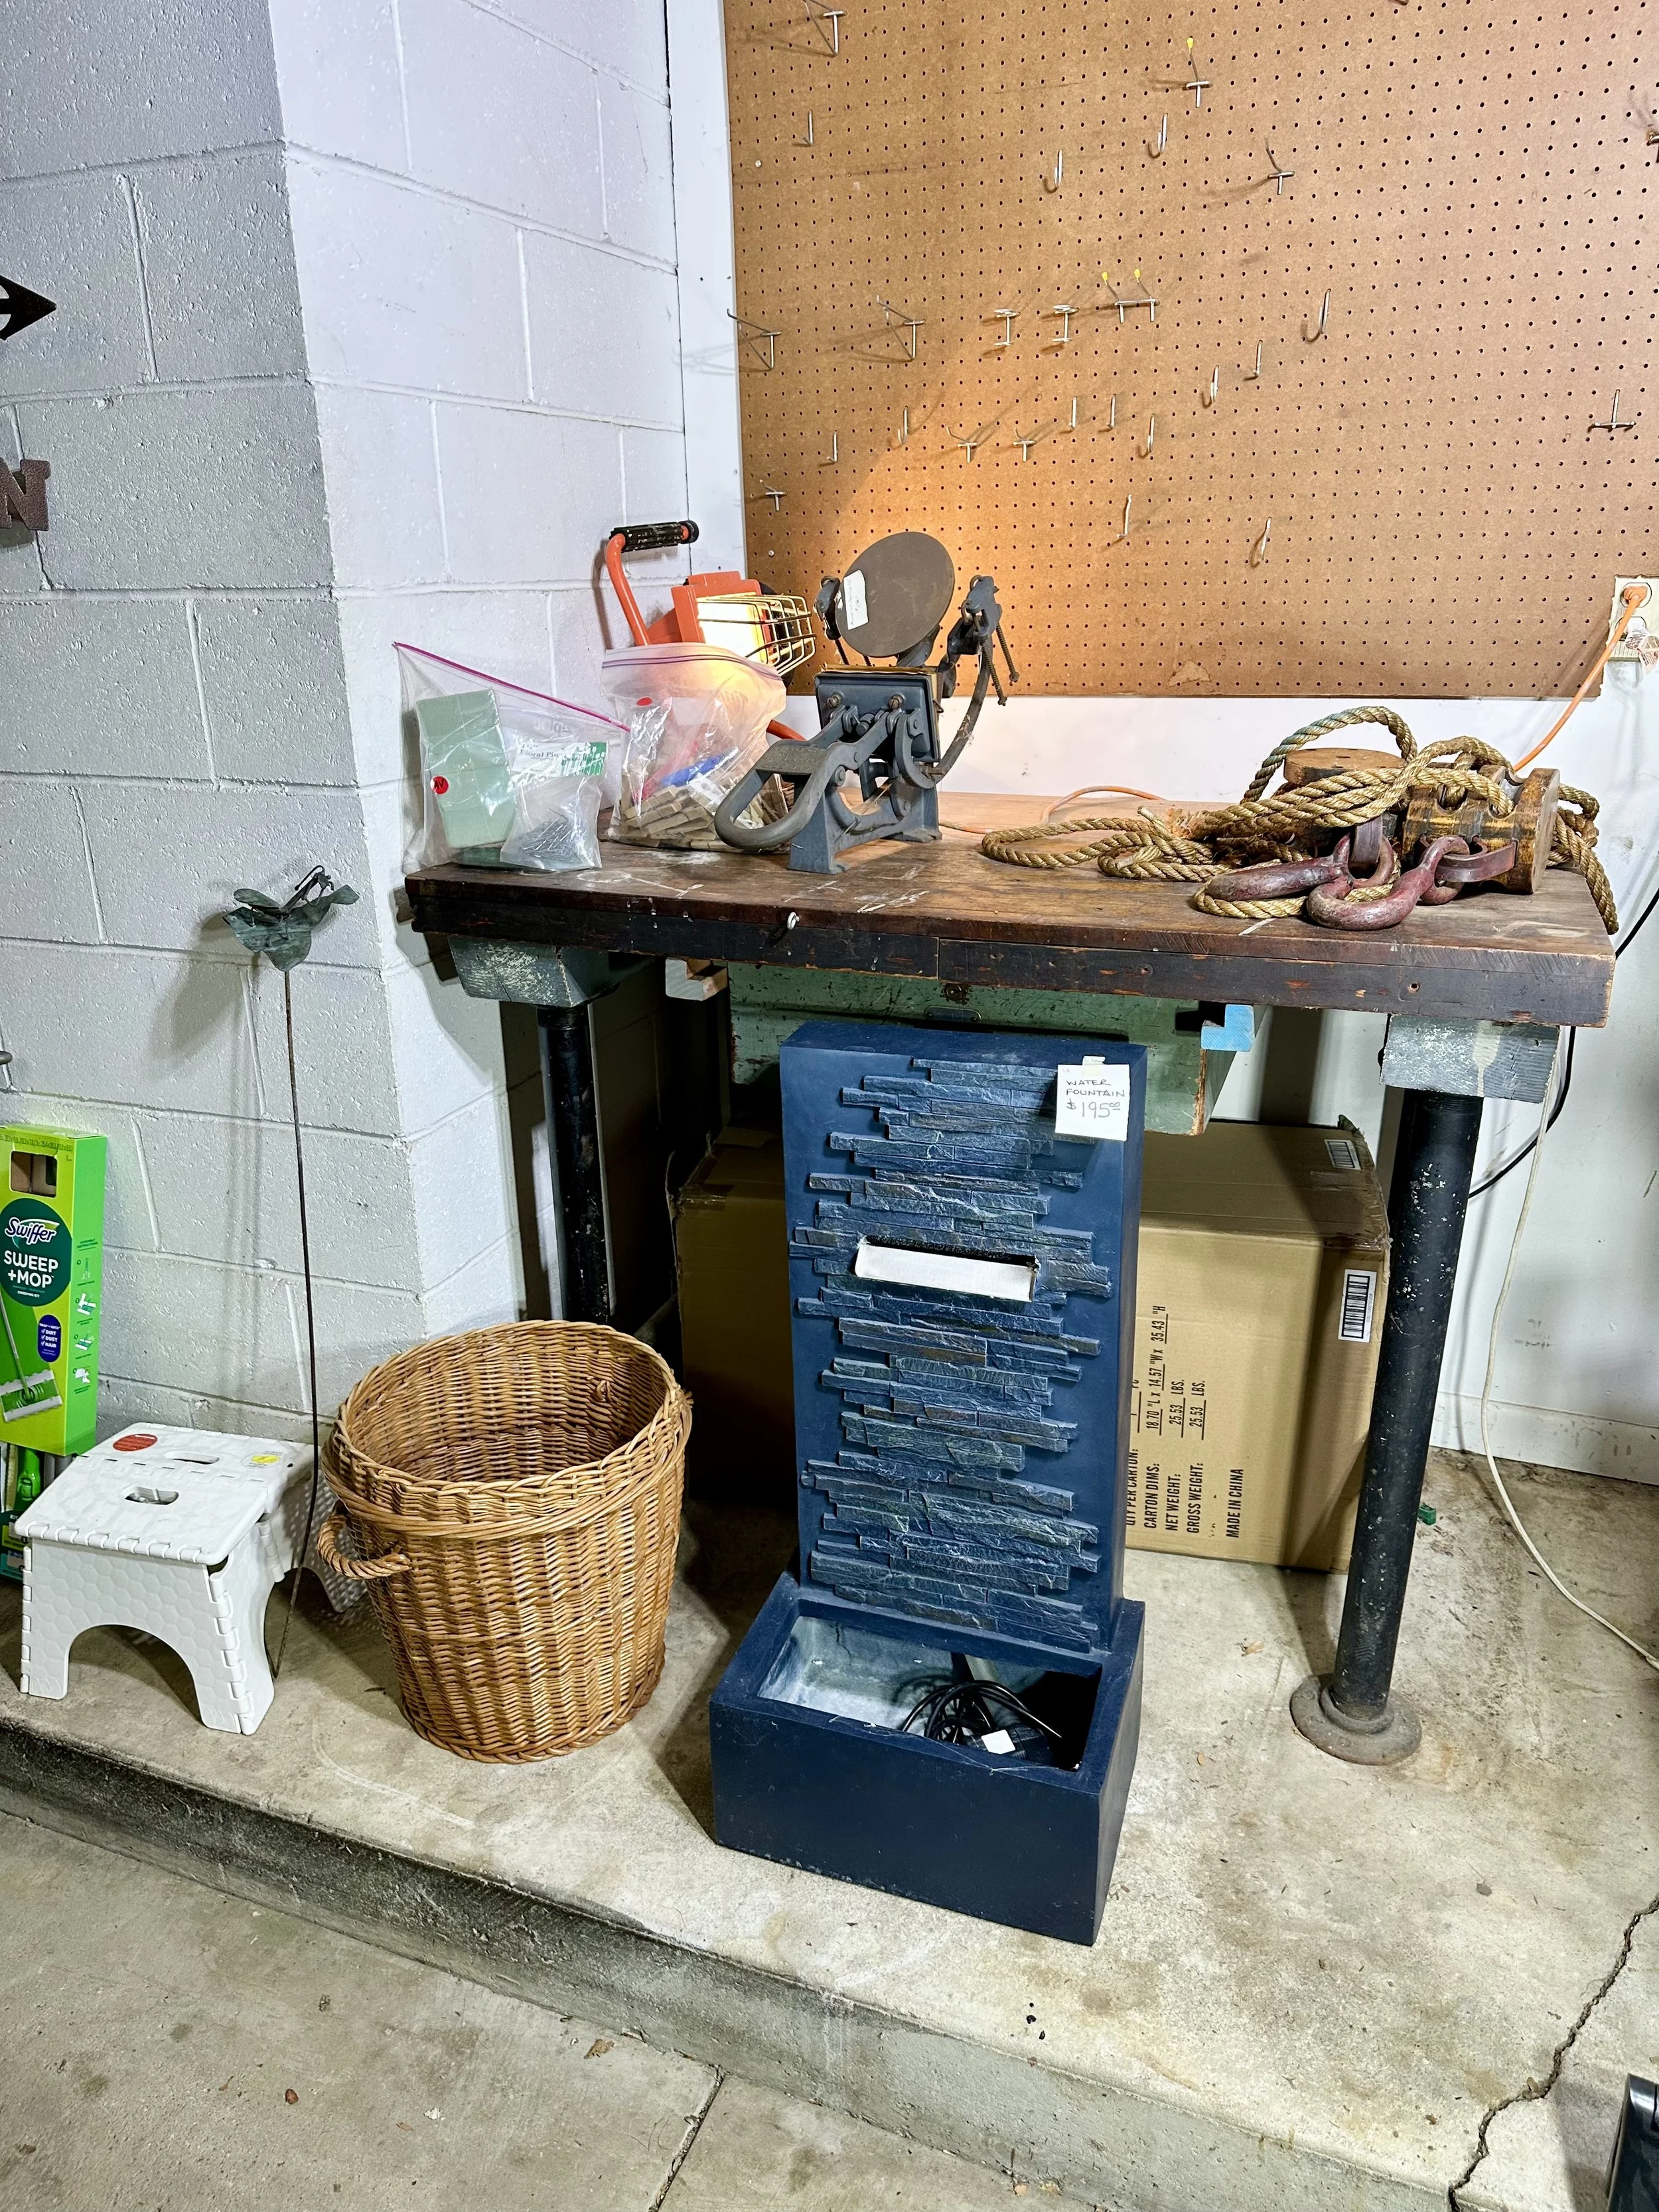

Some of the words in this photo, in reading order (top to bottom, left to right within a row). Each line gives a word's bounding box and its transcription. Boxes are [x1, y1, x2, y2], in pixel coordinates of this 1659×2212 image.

[1066, 1089, 1125, 1098] FOUNTAIN
[4, 1217, 57, 1246] Swiffer
[3, 1250, 59, 1273] SWEEP
[1151, 1320, 1165, 1342] 35.43
[1148, 1367, 1163, 1387] 14.57
[1171, 1379, 1185, 1395] LBS.
[1191, 1380, 1206, 1396] LBS.
[1146, 1410, 1160, 1430] 18.70
[1169, 1404, 1183, 1426] 25.53
[1189, 1406, 1204, 1428] 25.53
[1146, 1463, 1160, 1491] DIMS:
[1189, 1463, 1204, 1501] WEIGHT:
[1228, 1469, 1244, 1498] CHINA
[1166, 1473, 1181, 1512] WEIGHT:
[1143, 1492, 1158, 1529] CARTON
[1228, 1499, 1242, 1511] IN
[1165, 1513, 1179, 1531] NET
[1187, 1503, 1202, 1534] GROSS
[1226, 1512, 1241, 1538] MADE
